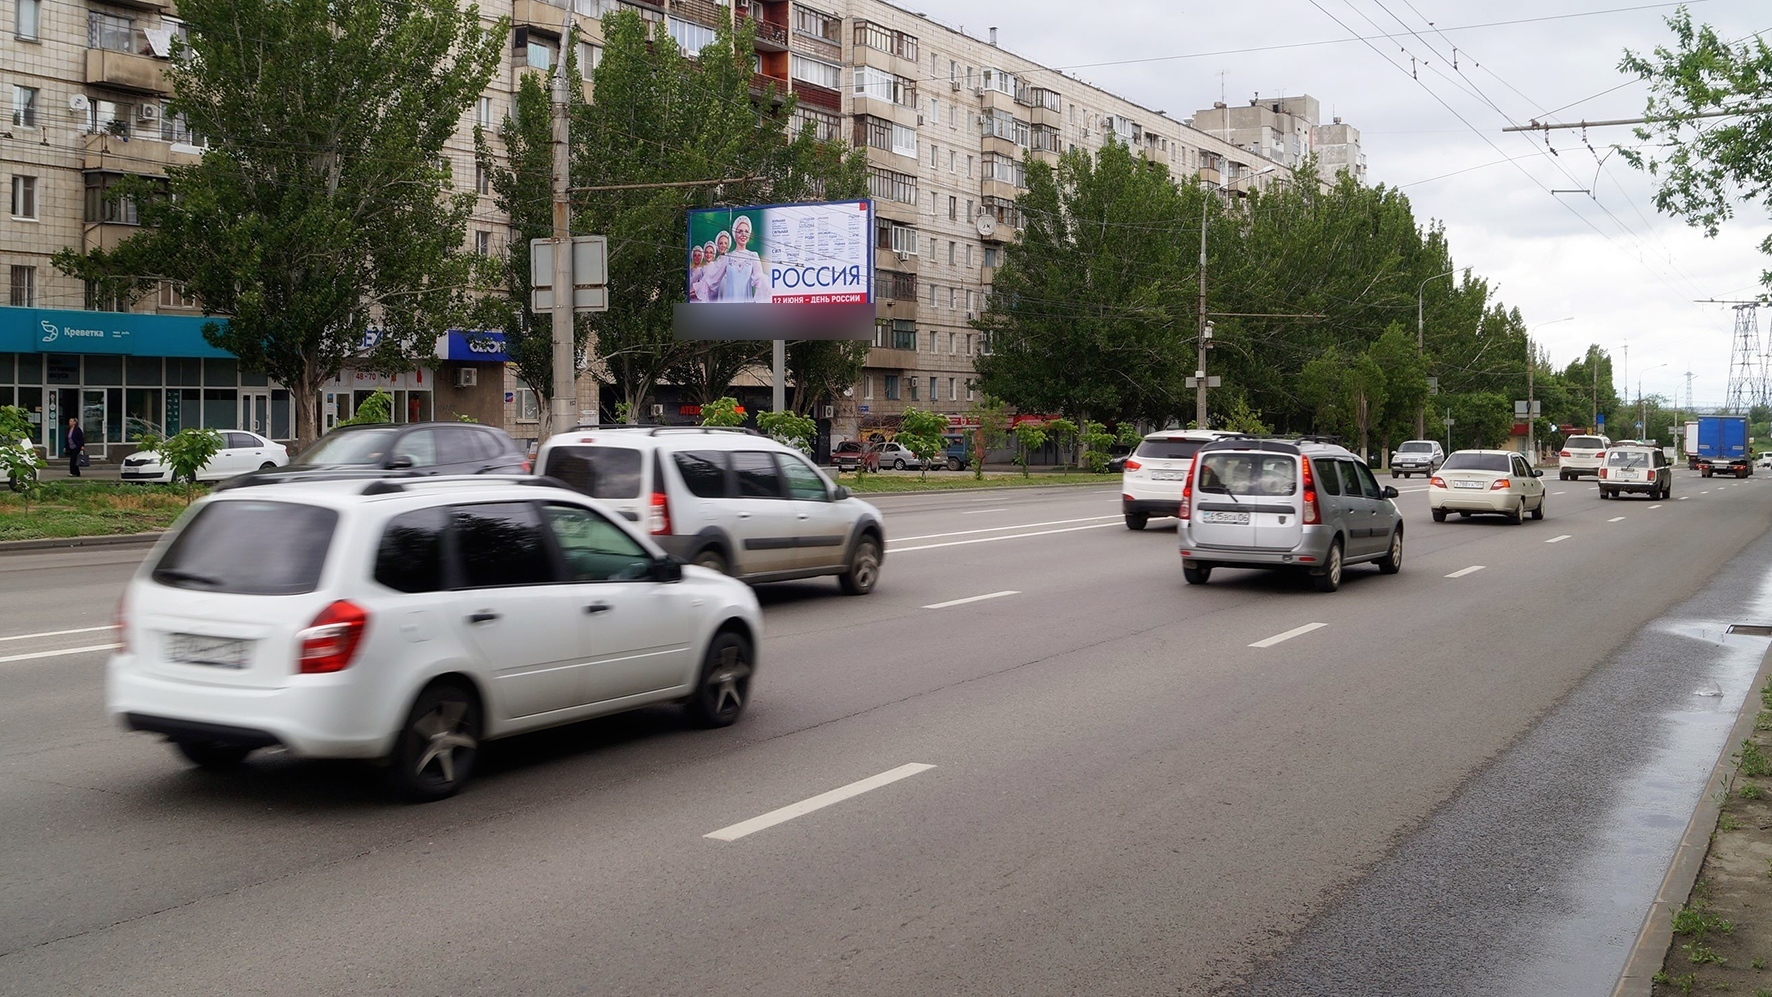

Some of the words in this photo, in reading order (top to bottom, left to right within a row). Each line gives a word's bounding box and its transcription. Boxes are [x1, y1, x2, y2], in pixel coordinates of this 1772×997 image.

[772, 265, 860, 289] РОССИЯ
[810, 295, 830, 304] ДЕНЬ
[831, 294, 861, 303] РОССИИ
[64, 327, 104, 338] Креветка
[680, 406, 702, 415] АТЕЛ
